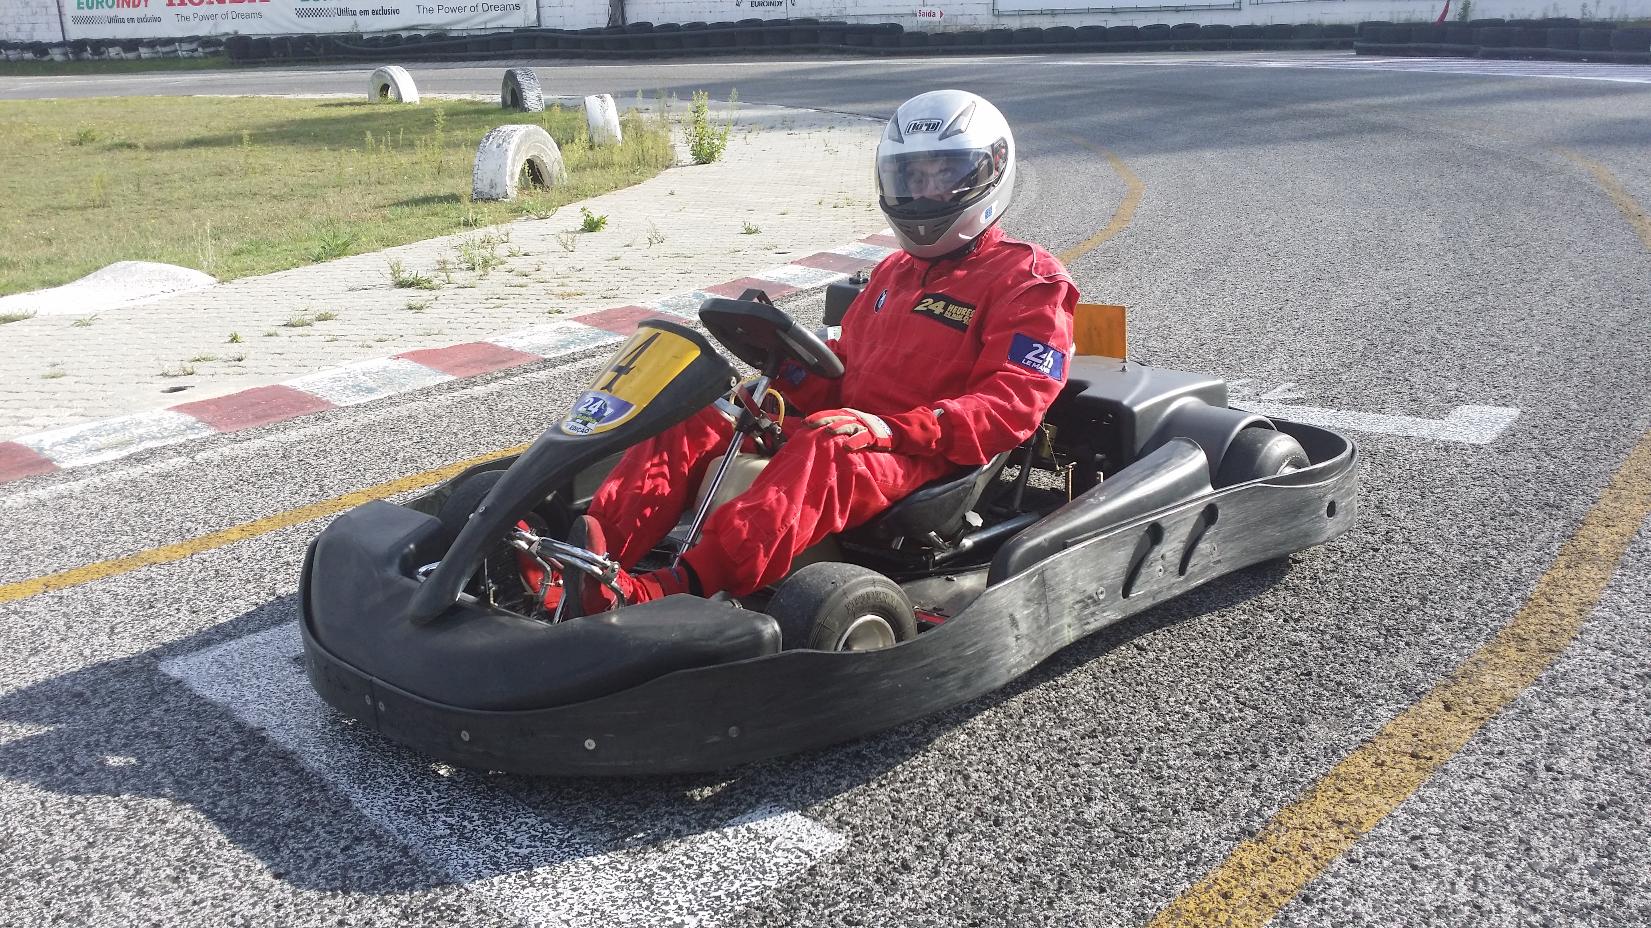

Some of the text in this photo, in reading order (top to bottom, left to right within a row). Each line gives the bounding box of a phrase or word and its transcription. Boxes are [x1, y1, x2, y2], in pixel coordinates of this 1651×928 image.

[372, 5, 400, 16] exclusivo
[416, 2, 521, 14] The Power of Dreams
[174, 10, 263, 22] The Power of Dreams
[913, 298, 946, 315] 24
[600, 331, 661, 393] 4
[1021, 358, 1032, 367] LE
[578, 397, 605, 415] 24
